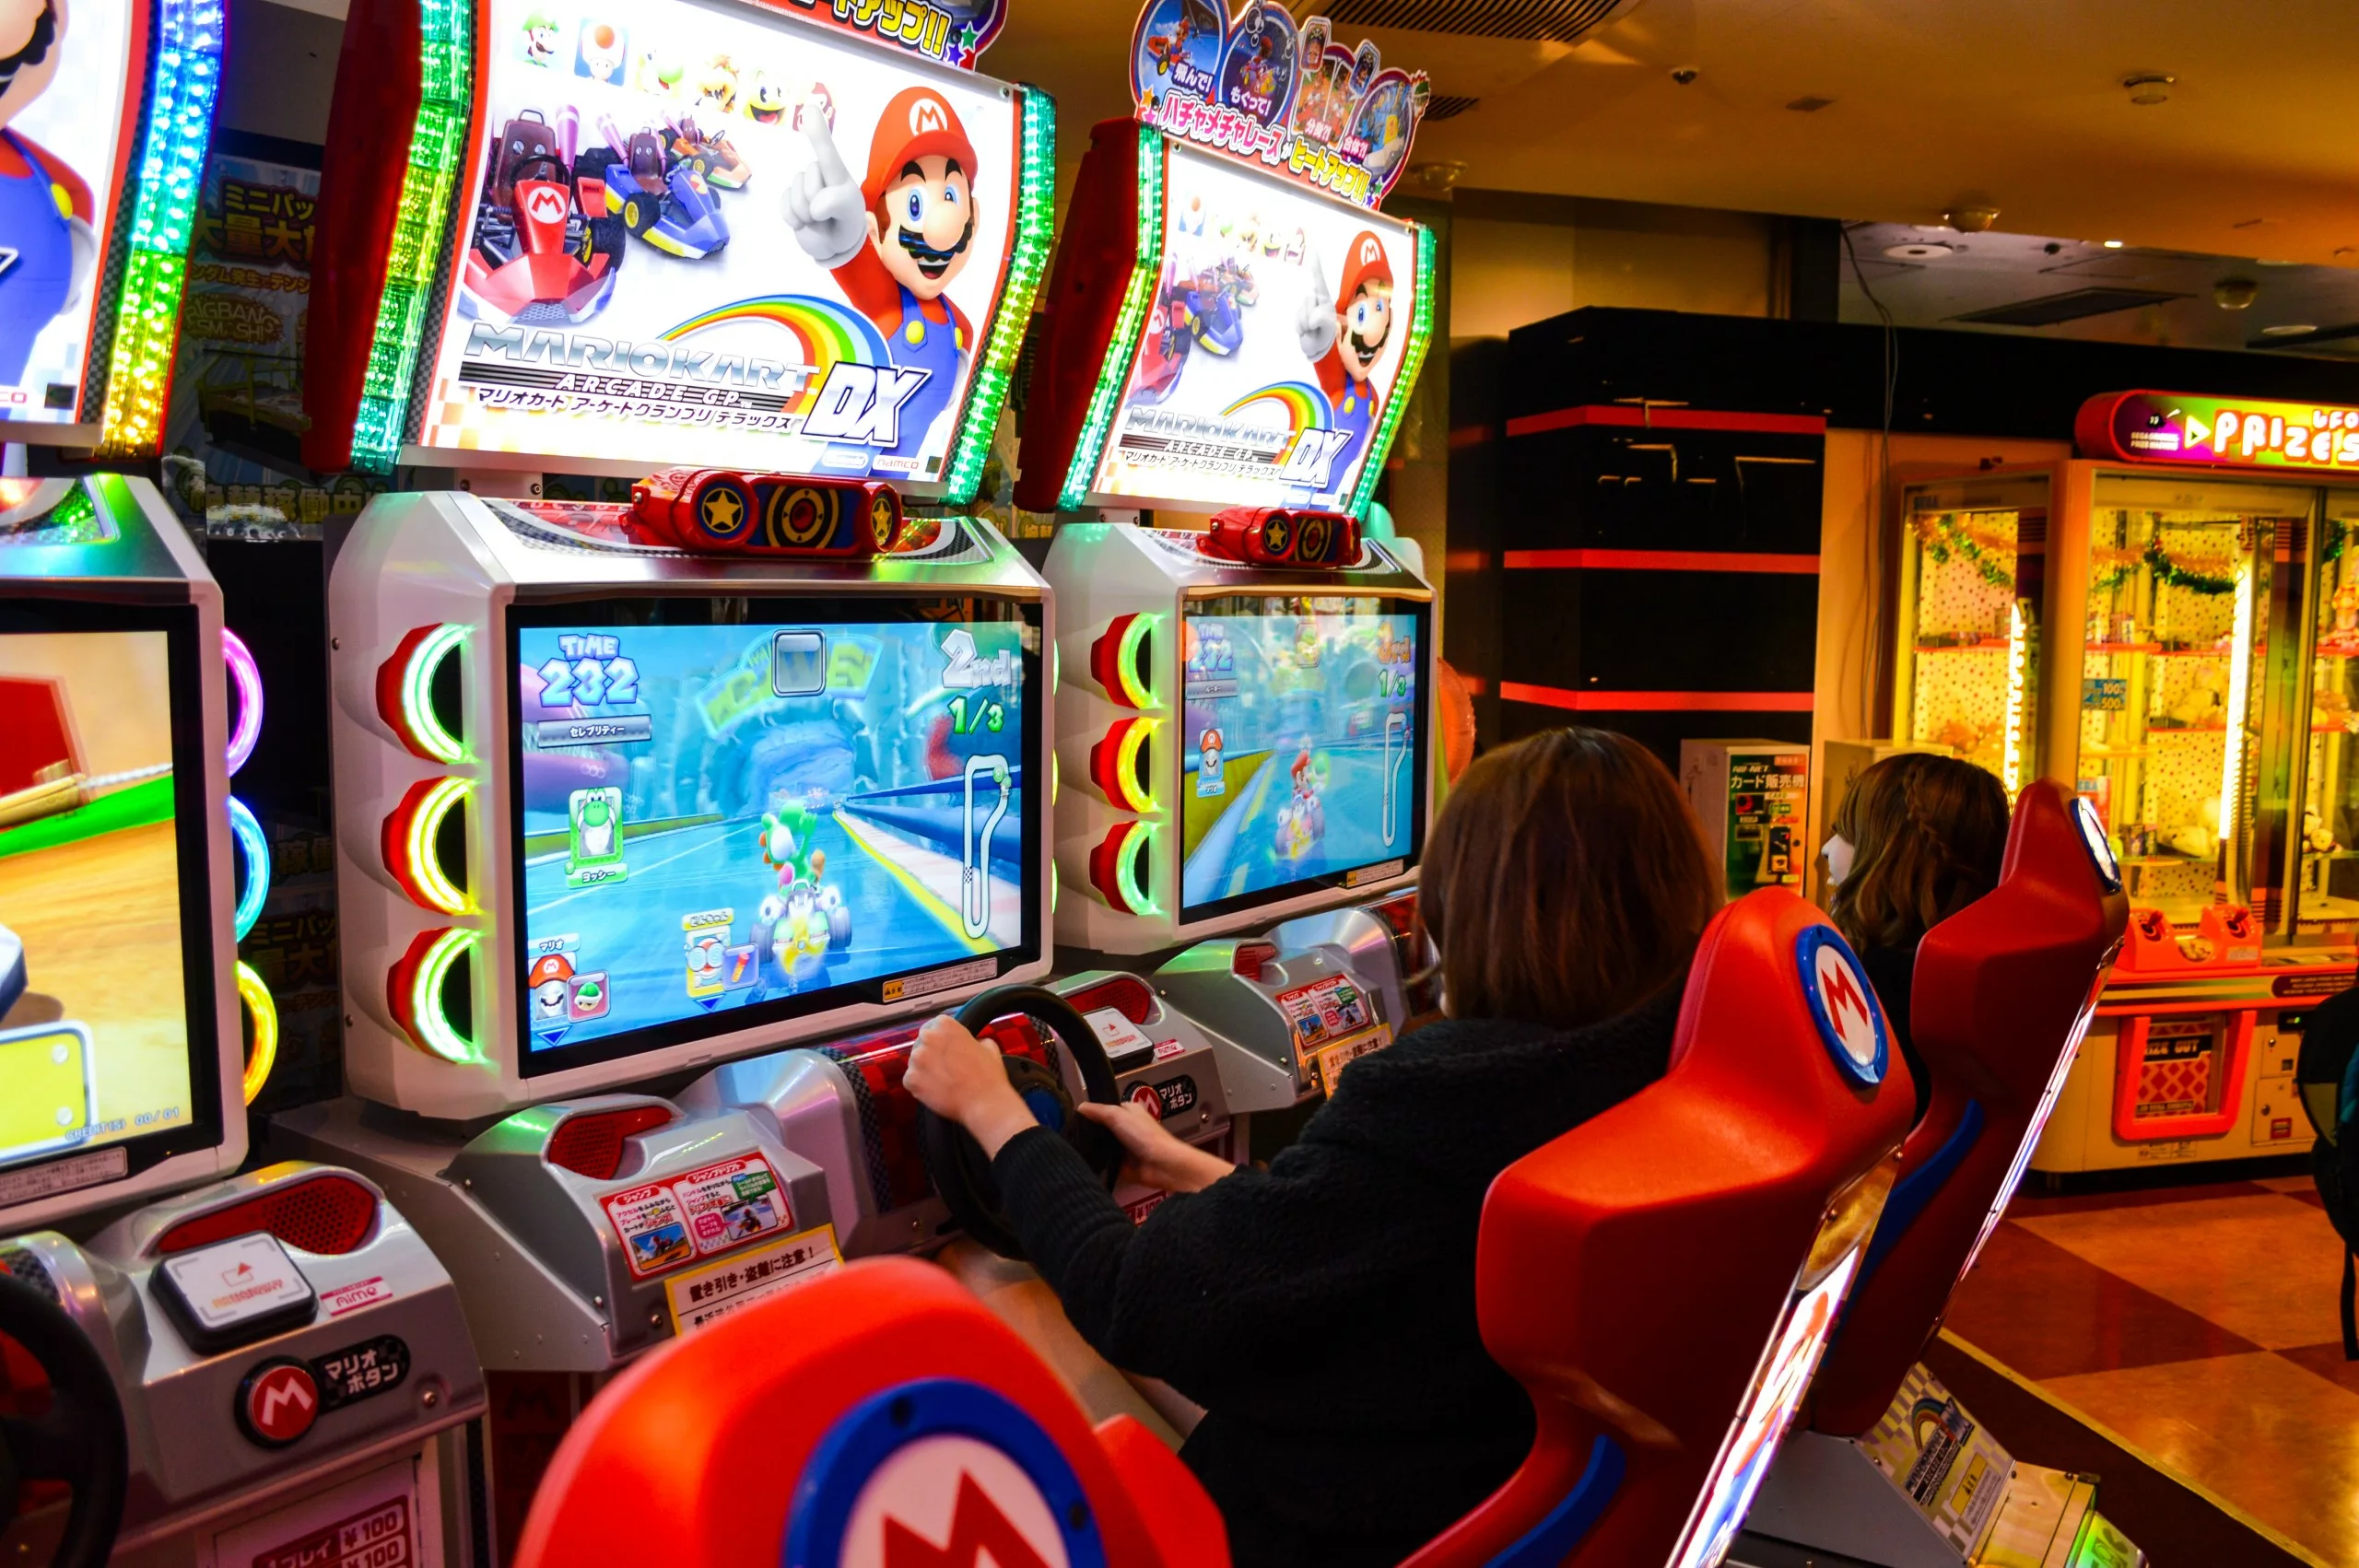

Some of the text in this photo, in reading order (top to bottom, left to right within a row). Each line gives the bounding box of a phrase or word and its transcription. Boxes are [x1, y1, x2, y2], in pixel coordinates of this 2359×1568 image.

[477, 387, 566, 410] マリオカート
[555, 373, 688, 403] ARCADE
[701, 389, 740, 407] GP
[803, 360, 933, 447] DX
[1164, 439, 1227, 457] ARCADE
[1279, 427, 1354, 486] DX
[558, 633, 620, 661] TIME
[940, 628, 1012, 689] 2nd
[537, 656, 640, 708] 232
[947, 696, 1005, 735] 1/3
[1820, 959, 1868, 1041] M
[1159, 1082, 1183, 1099] マリオ
[1169, 1093, 1193, 1110] ボタン
[65, 1118, 127, 1141] CREDIT(S)
[324, 1350, 379, 1381] マリオ
[346, 1362, 400, 1395] ボタン
[261, 1375, 313, 1427] M
